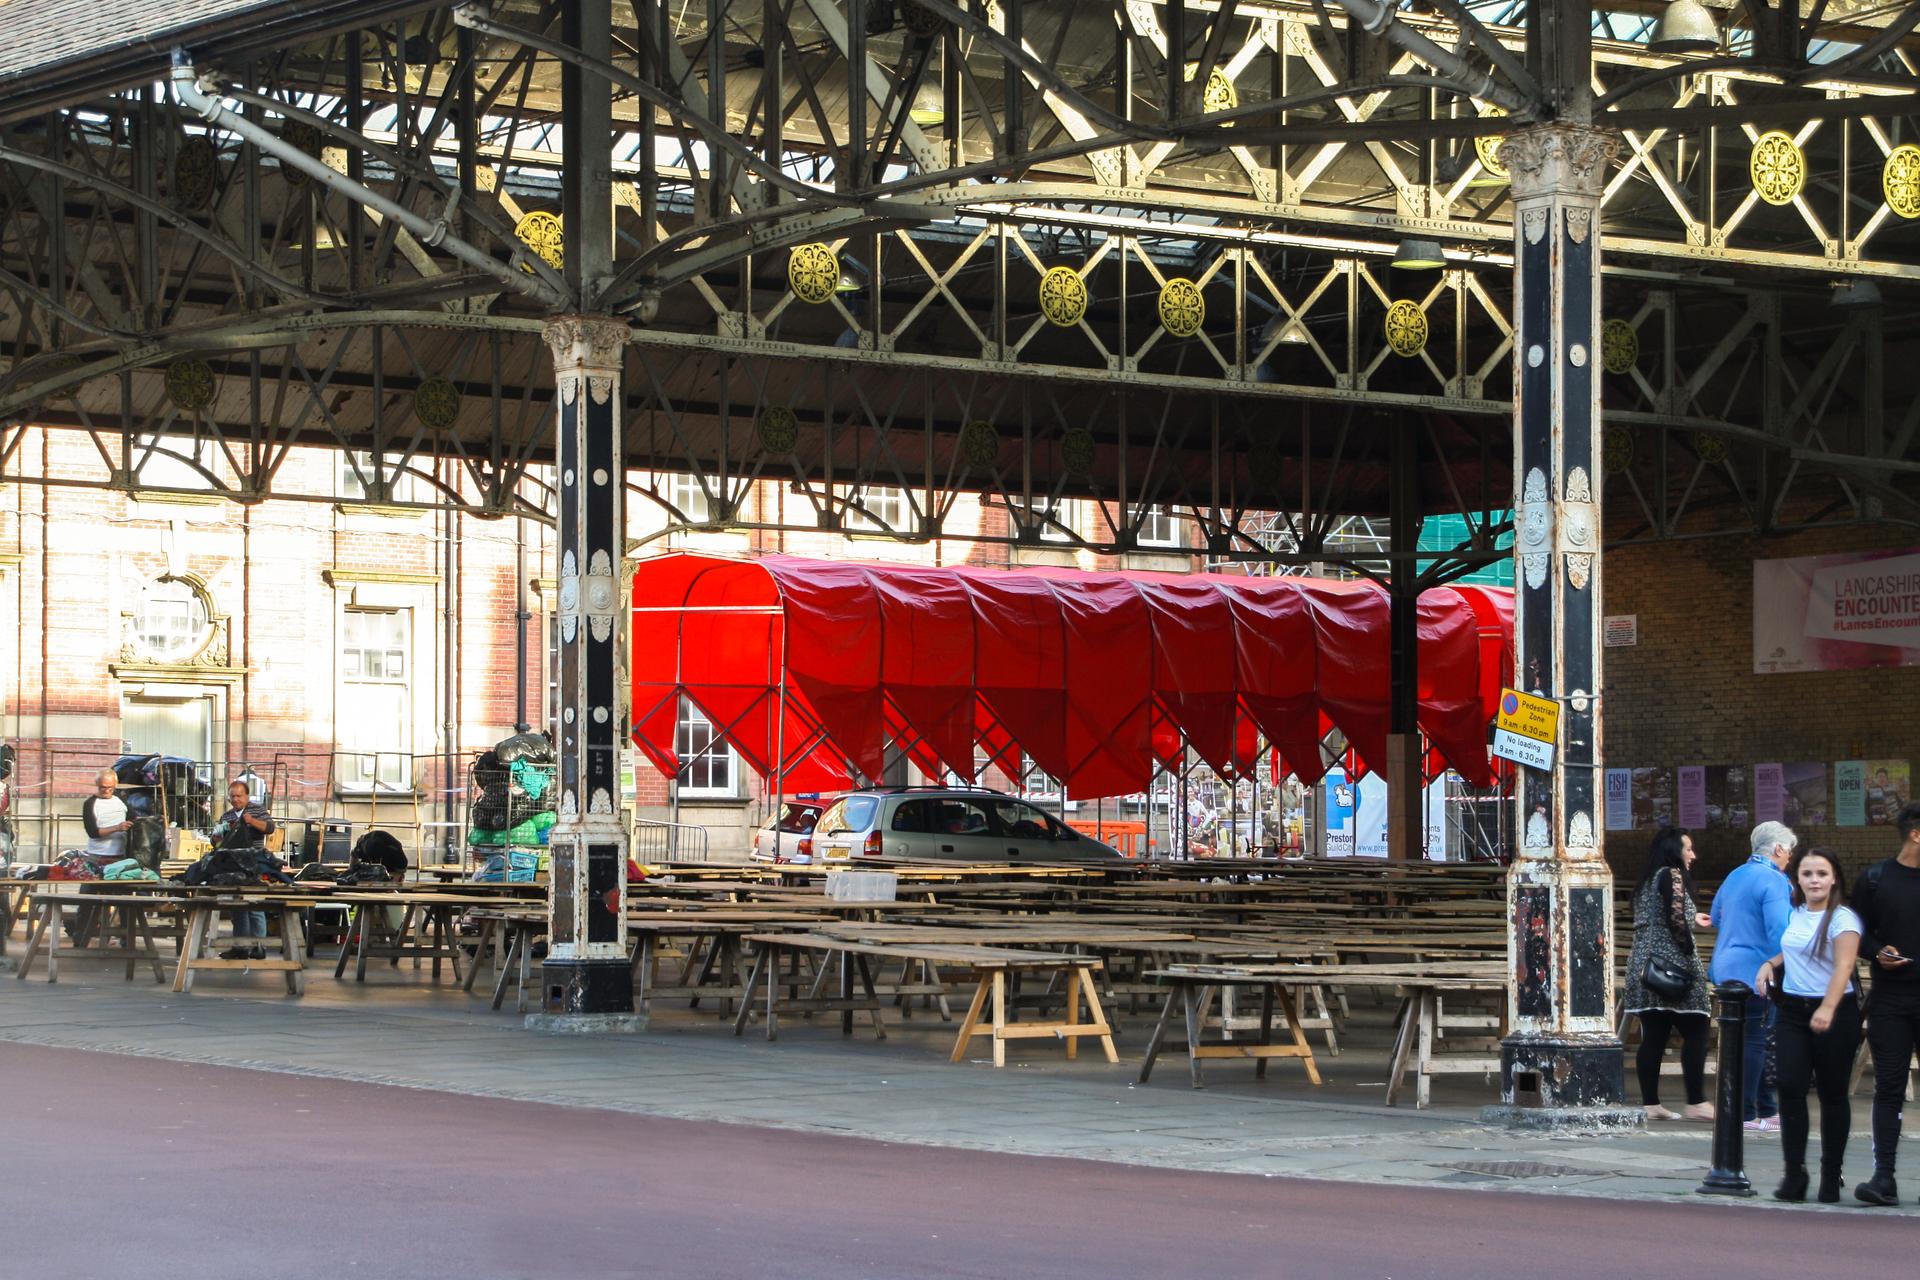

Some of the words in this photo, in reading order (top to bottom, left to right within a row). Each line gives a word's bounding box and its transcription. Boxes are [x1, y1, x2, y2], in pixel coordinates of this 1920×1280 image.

[1835, 574, 1920, 597] LANCASHIR
[1835, 595, 1920, 616] ENCOUNTE
[1522, 700, 1555, 716] Pedestrian
[1529, 712, 1544, 722] Zone
[1522, 725, 1538, 734] 6.30
[1507, 736, 1516, 744] No
[1518, 739, 1540, 752] loading
[1519, 751, 1534, 761] 6.30
[1608, 773, 1628, 791] FISH
[1839, 779, 1861, 791] OPEN
